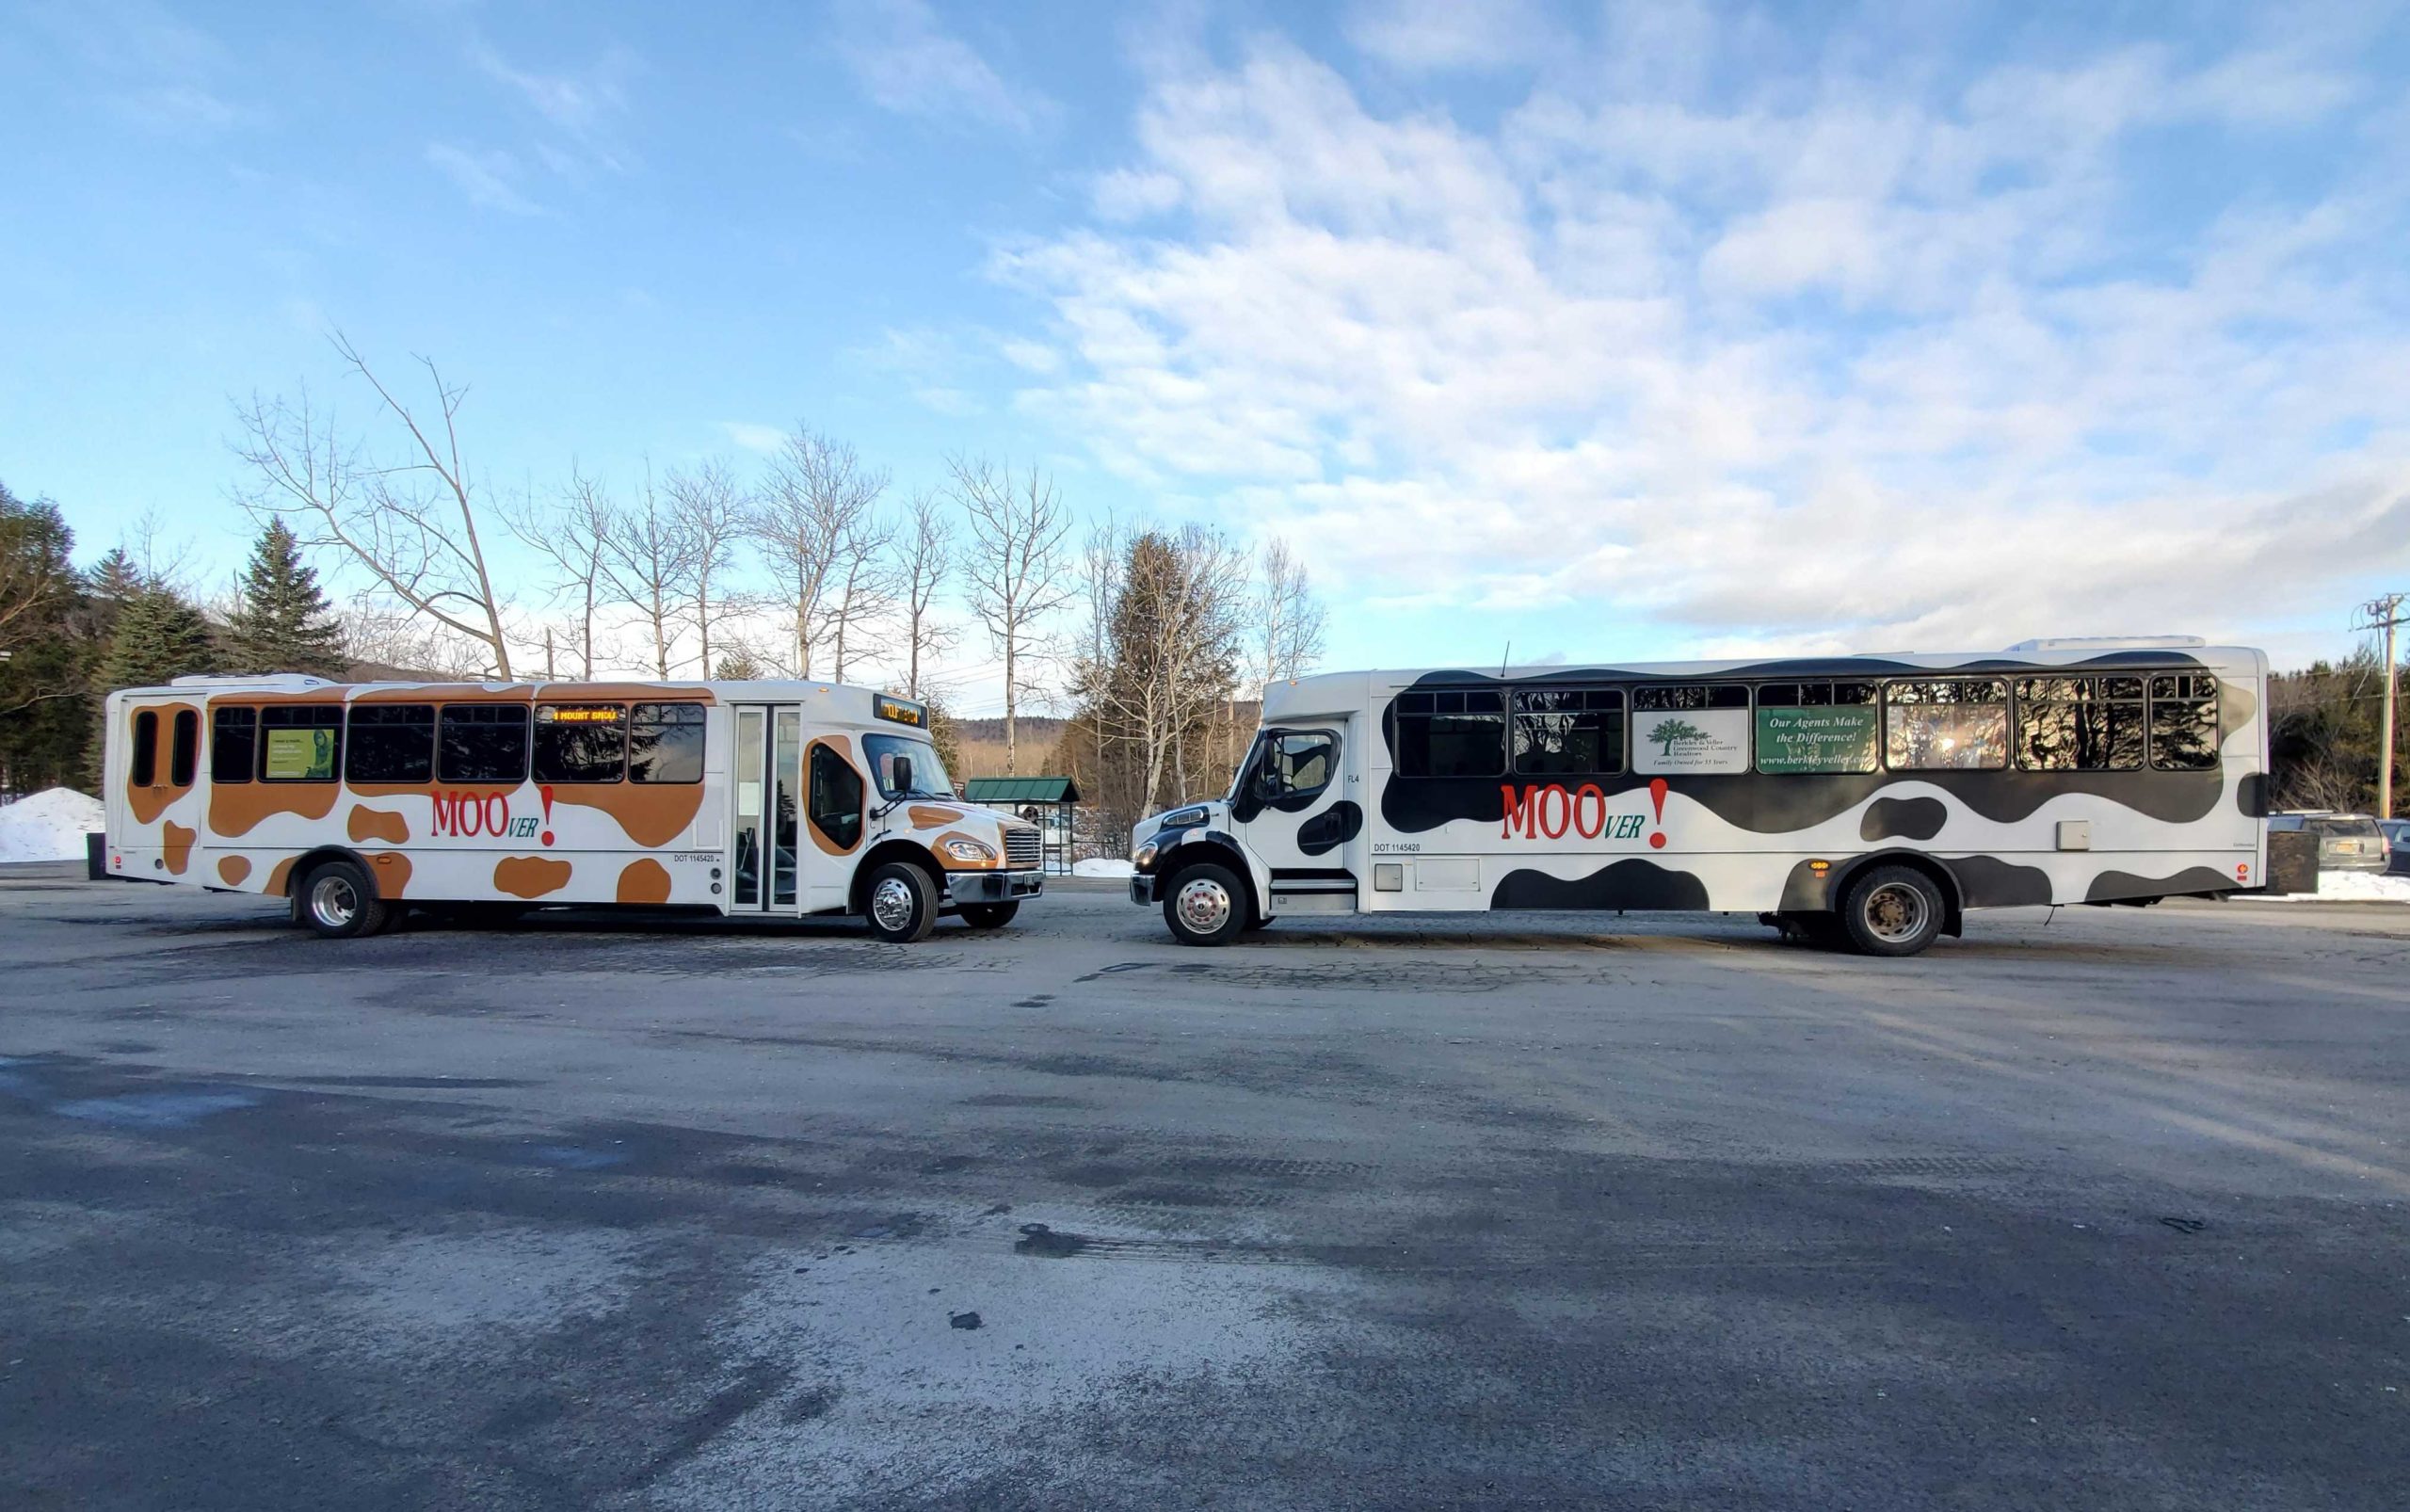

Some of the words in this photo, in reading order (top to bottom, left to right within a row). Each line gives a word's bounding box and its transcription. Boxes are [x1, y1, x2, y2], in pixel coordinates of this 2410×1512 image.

[560, 711, 589, 720] MOUNT
[1770, 717, 1791, 728] Our
[1793, 717, 1830, 730] Agents
[1833, 716, 1864, 727] Make
[1776, 733, 1793, 743] the
[1796, 732, 1857, 745] Difference!
[1347, 774, 1359, 783] FL4
[1392, 844, 1421, 852] 1145420
[674, 854, 688, 862] DOT
[689, 854, 715, 862] 1145420
